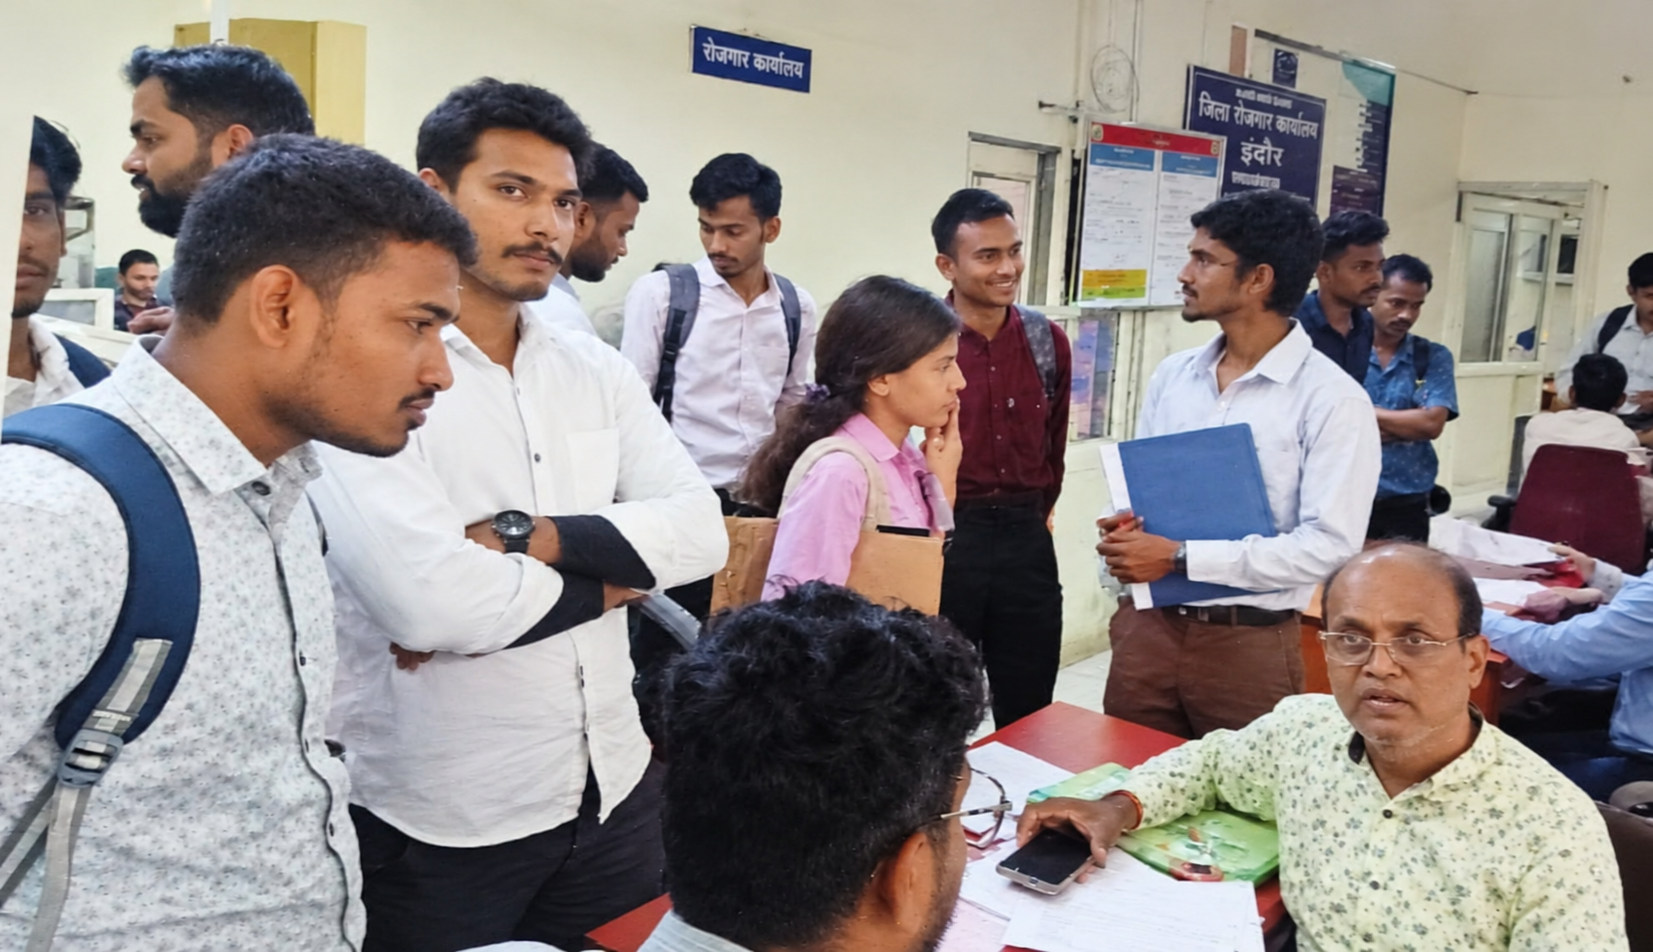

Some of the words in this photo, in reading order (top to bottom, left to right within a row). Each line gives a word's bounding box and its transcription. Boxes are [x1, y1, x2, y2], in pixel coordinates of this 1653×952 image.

[702, 36, 750, 69] रोजगार
[753, 51, 804, 78] कार्यालय
[1198, 90, 1231, 123] जिला
[1233, 99, 1274, 131] रोजगार
[1275, 111, 1319, 139] कार्यालय
[1240, 136, 1284, 167] इंदौर
